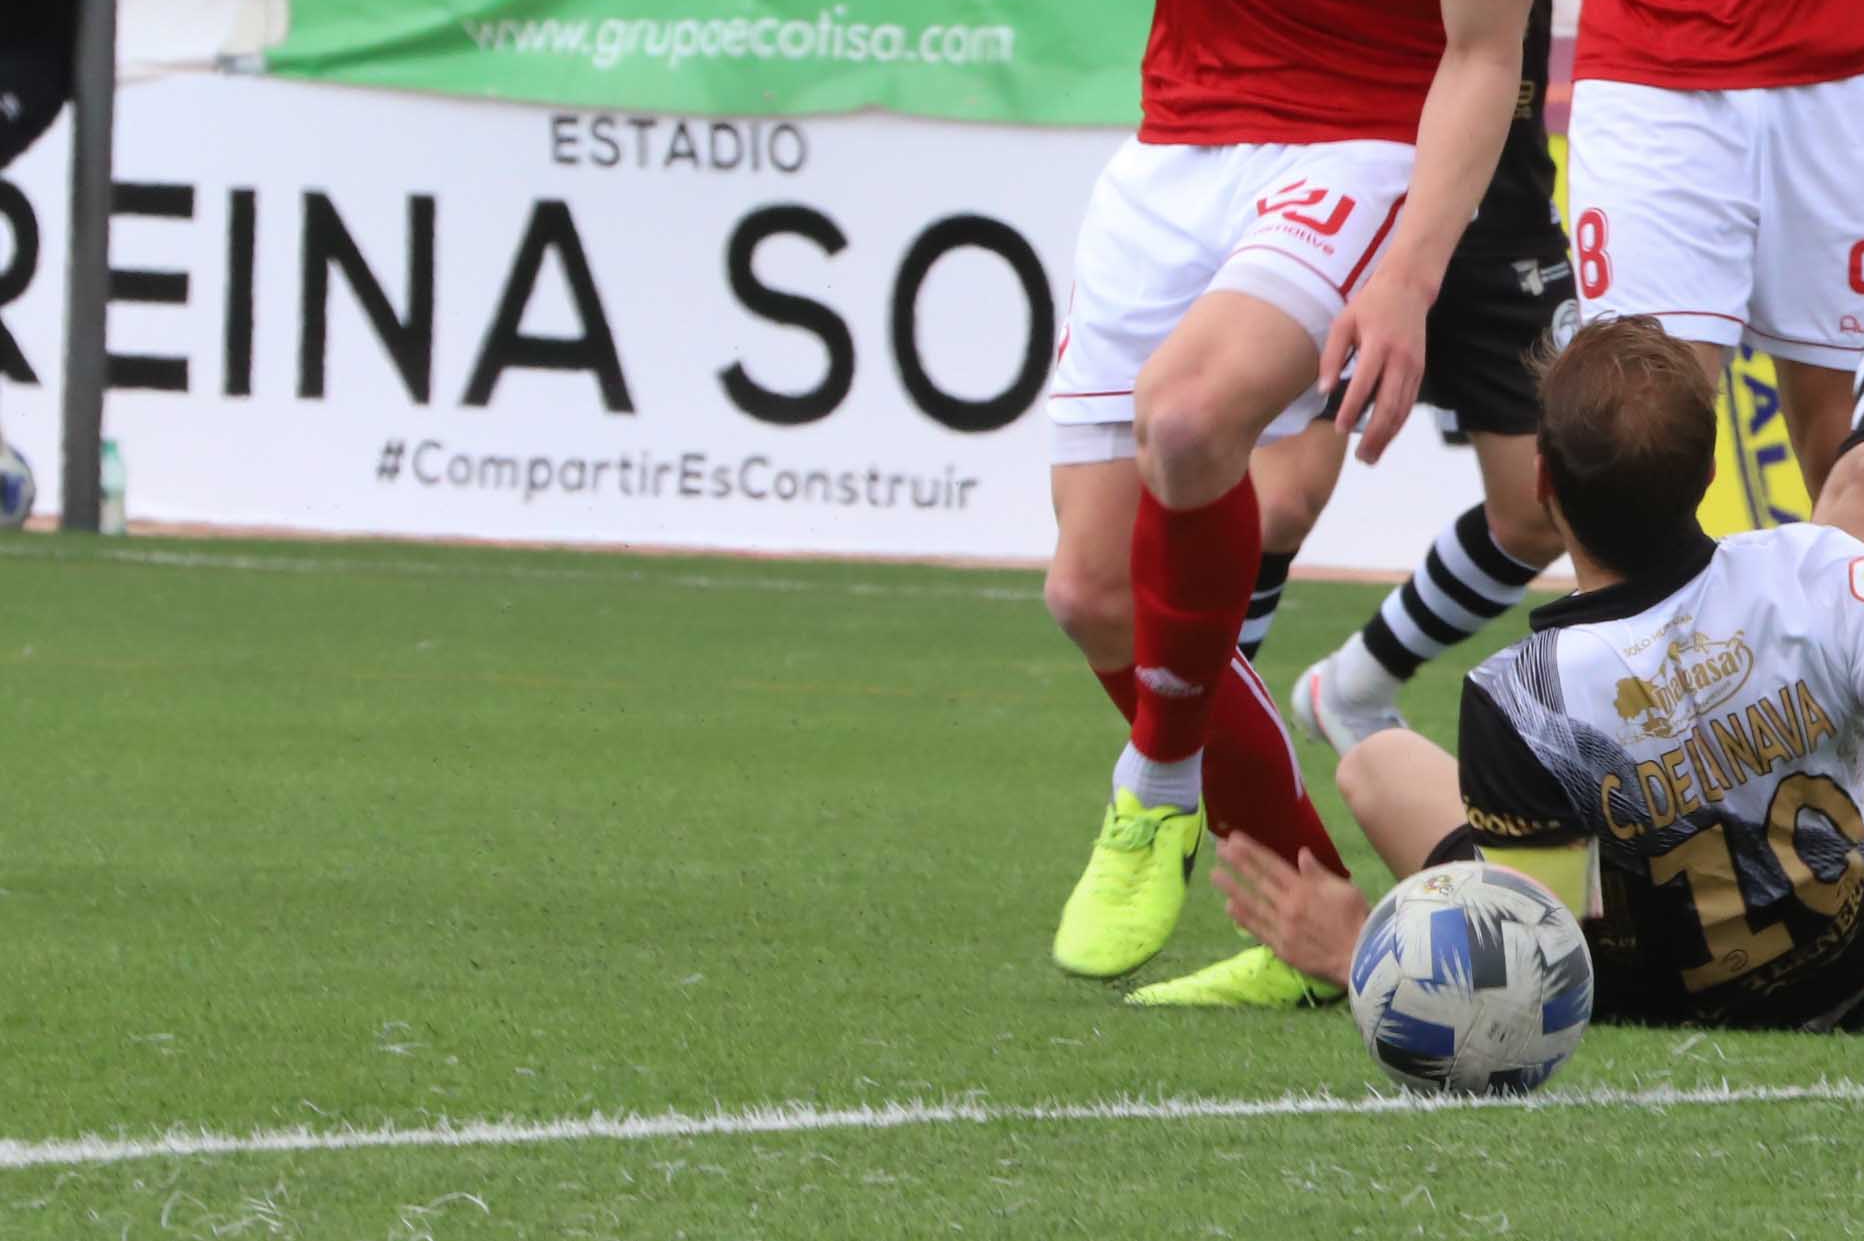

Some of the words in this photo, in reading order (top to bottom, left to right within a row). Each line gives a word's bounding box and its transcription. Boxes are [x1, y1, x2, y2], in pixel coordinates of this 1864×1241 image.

[464, 10, 1017, 69] www.grupoecotisa.com
[549, 116, 809, 174] ESTADIO
[1578, 208, 1612, 300] 8
[376, 438, 981, 512] #CompartirEsConstruir
[1600, 772, 1647, 841] C.
[1636, 744, 1702, 829] DE
[1709, 678, 1838, 785] NAVA
